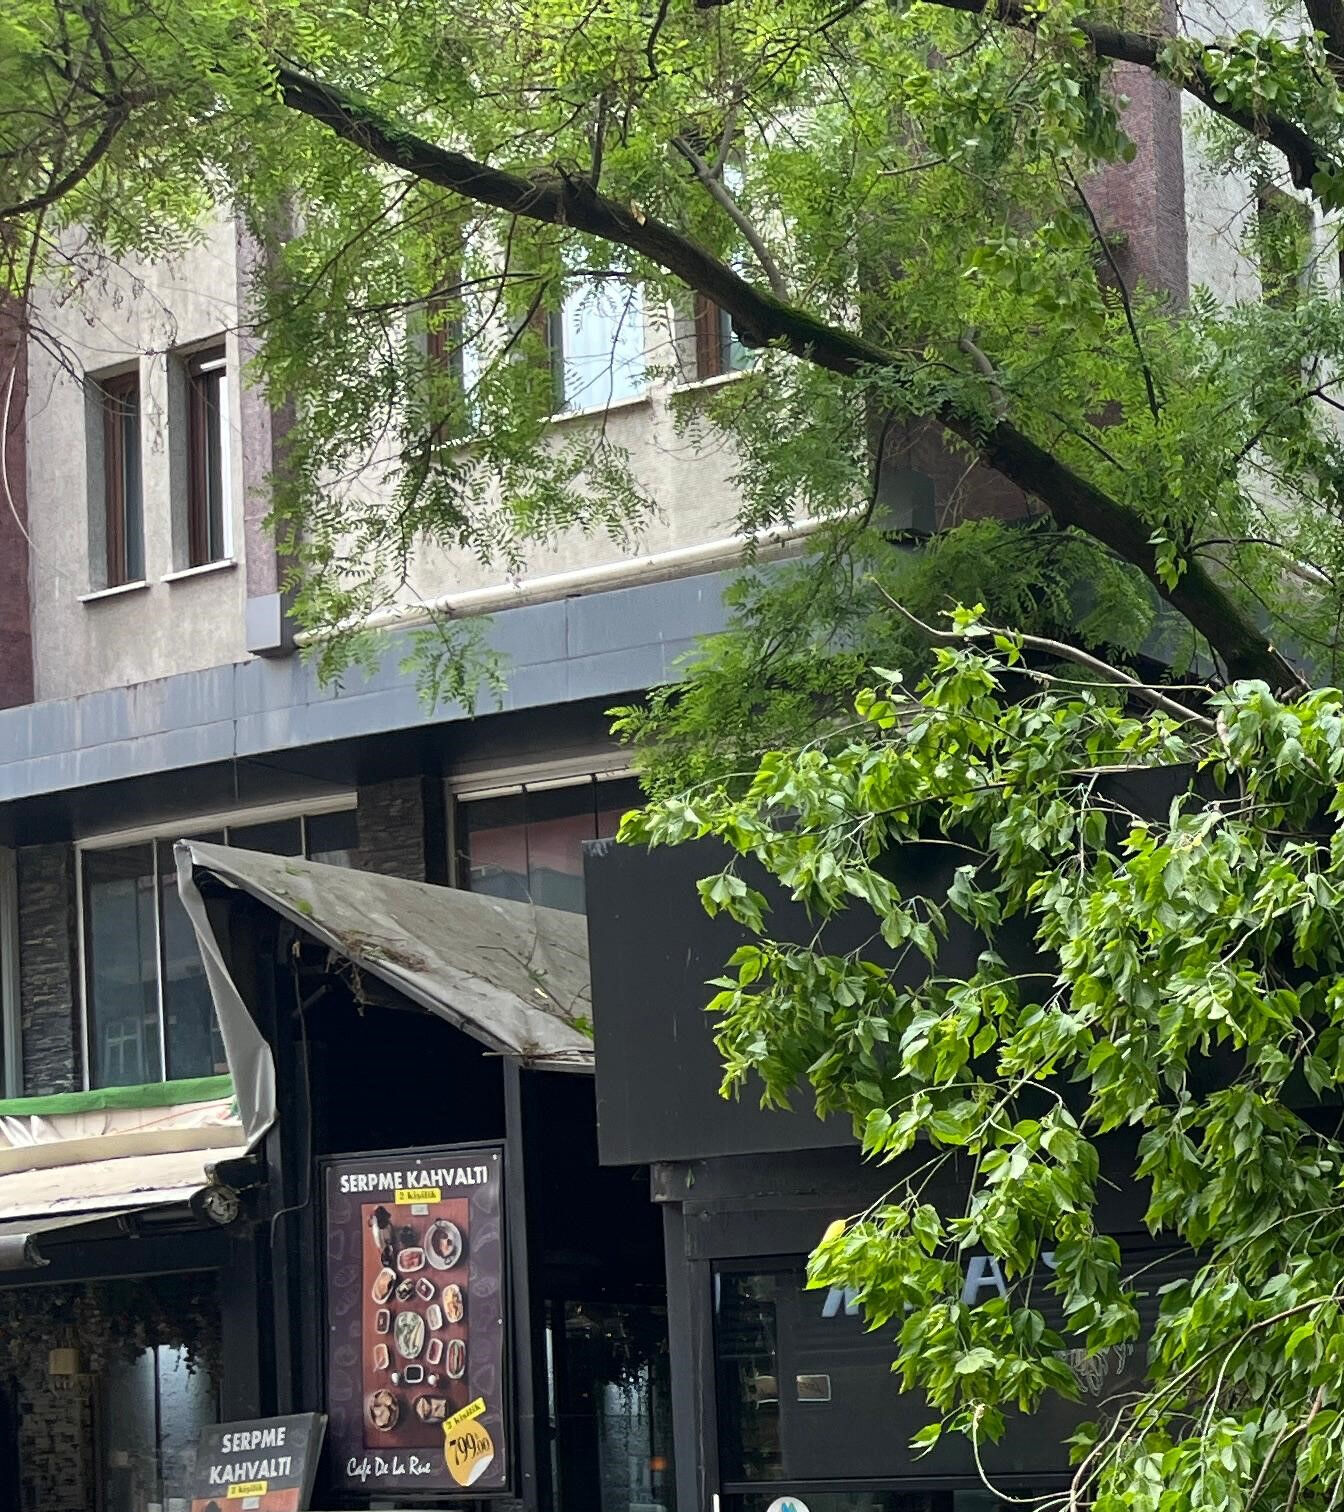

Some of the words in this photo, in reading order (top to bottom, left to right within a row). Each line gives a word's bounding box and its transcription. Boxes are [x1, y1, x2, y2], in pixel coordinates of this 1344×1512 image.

[340, 1171, 403, 1194] SERPME
[407, 1165, 488, 1188] KAHVALTI
[221, 1426, 287, 1454] SERPME
[209, 1456, 292, 1485] KAHVALTI
[347, 1456, 372, 1482] Cafe
[374, 1456, 389, 1476] De
[392, 1456, 406, 1475] La
[409, 1455, 431, 1476] Rue
